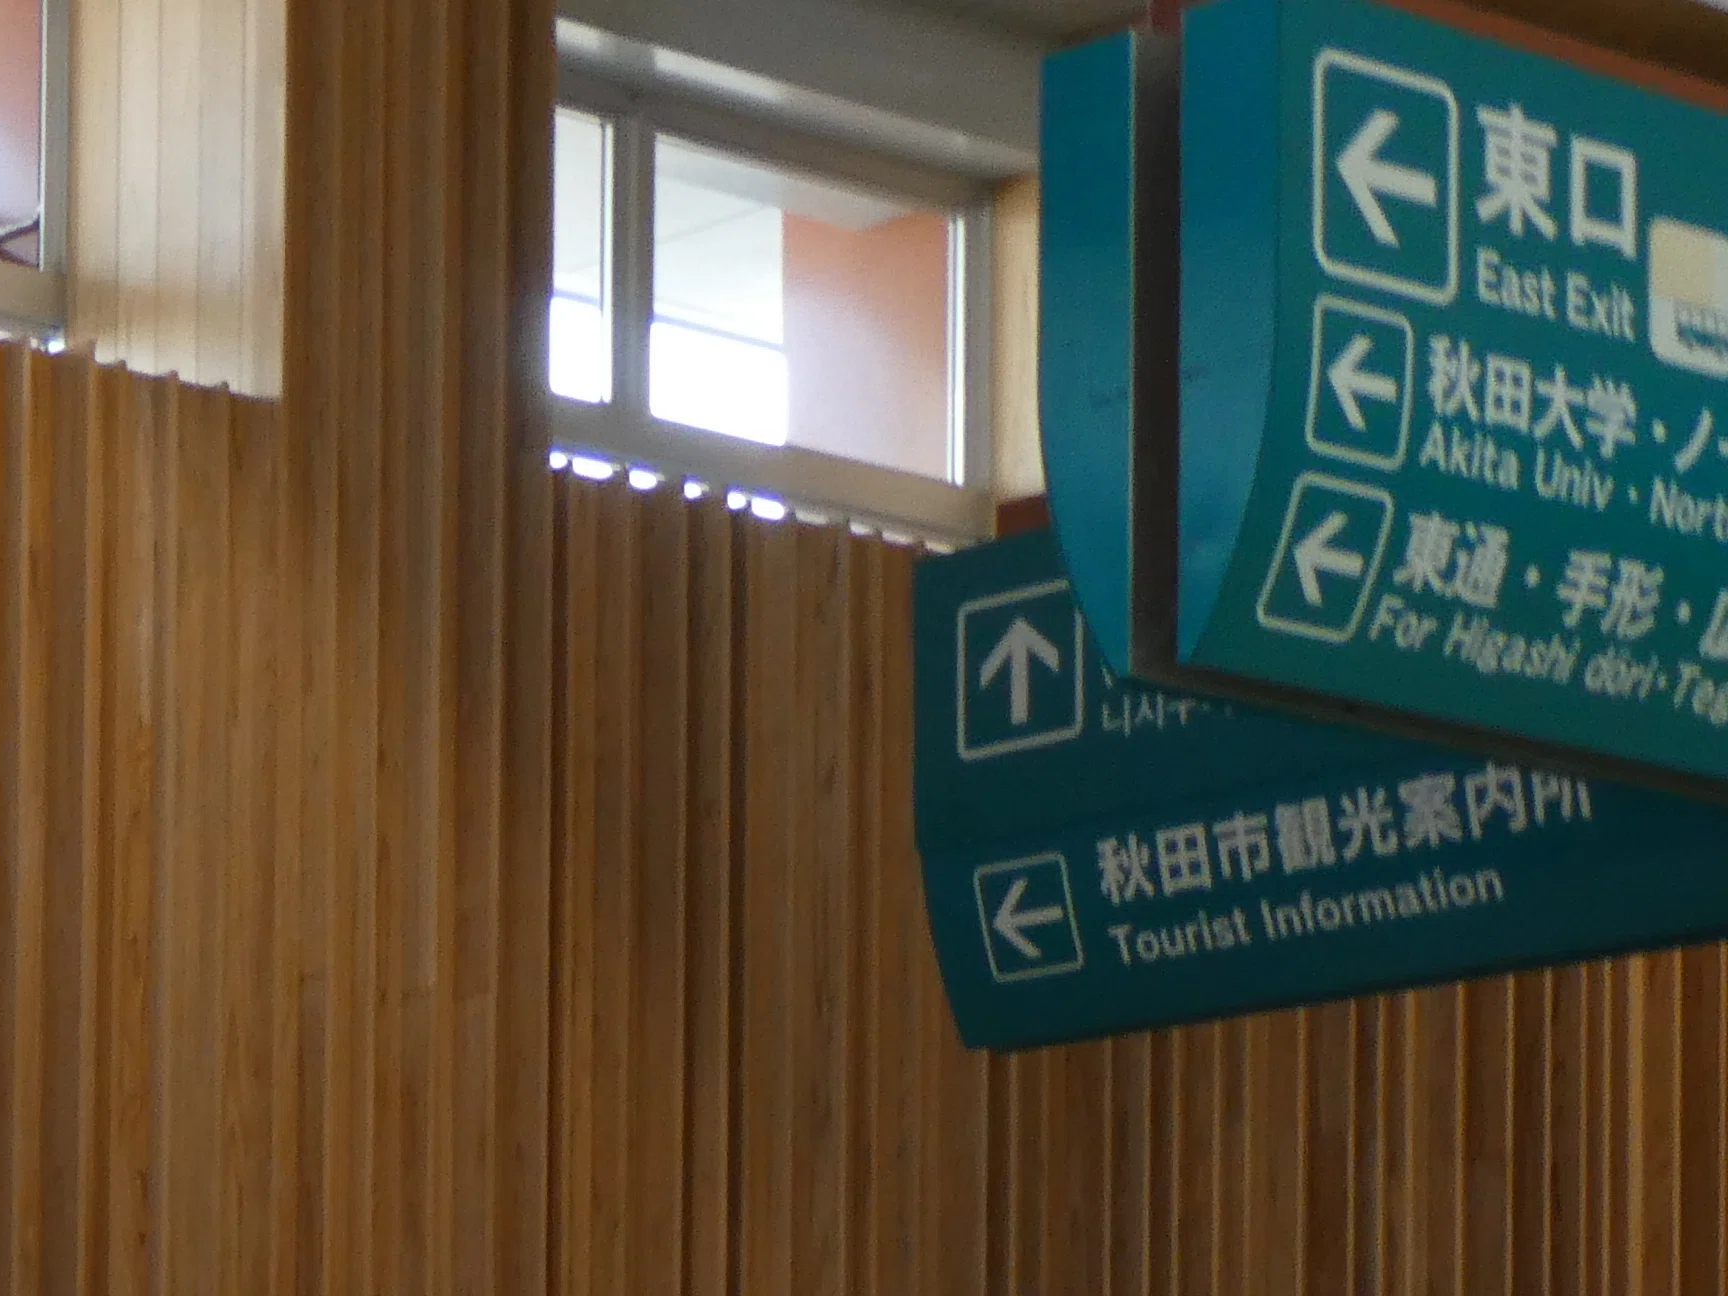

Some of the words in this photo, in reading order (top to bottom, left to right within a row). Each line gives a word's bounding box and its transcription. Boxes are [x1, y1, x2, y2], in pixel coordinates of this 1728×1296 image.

[1475, 100, 1638, 260] 東口
[1476, 247, 1556, 321] East
[1566, 271, 1636, 342] Exit
[1428, 333, 1728, 475] 秋田大学・ノ
[1419, 421, 1520, 490] Akita
[1534, 446, 1615, 511] Univ
[1369, 594, 1438, 651] For
[1109, 906, 1252, 968] Tourist
[1261, 866, 1505, 942] Information
